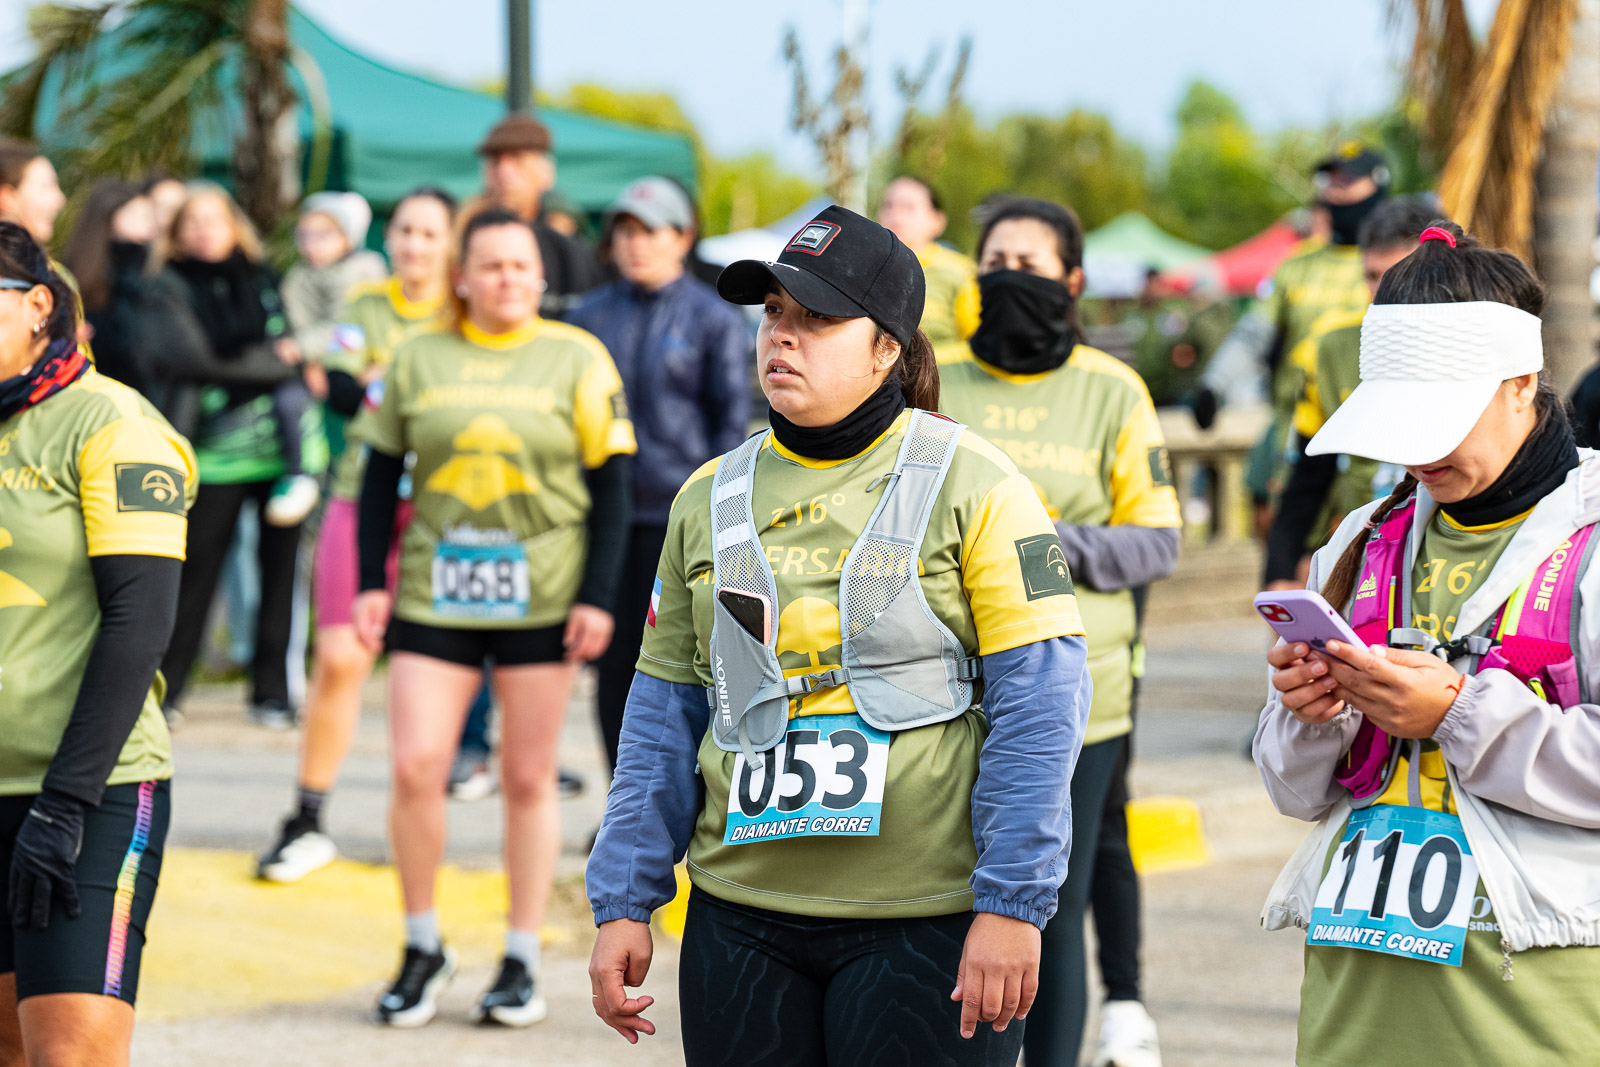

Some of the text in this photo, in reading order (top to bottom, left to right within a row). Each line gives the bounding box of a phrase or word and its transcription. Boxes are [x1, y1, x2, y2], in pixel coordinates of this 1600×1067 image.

[983, 403, 1048, 433] 216°
[0, 428, 20, 457] 6°
[989, 437, 1102, 478] RSARIO
[0, 463, 57, 491] ARIO
[769, 492, 846, 528] 216°
[1533, 540, 1573, 613] AONIJIE
[714, 654, 732, 727] AONIJIE
[738, 729, 869, 819] 053
[730, 817, 873, 842] DIAMANTE CORRE
[1331, 828, 1463, 931] 110
[1311, 924, 1454, 960] DIAMANTE CORRE
